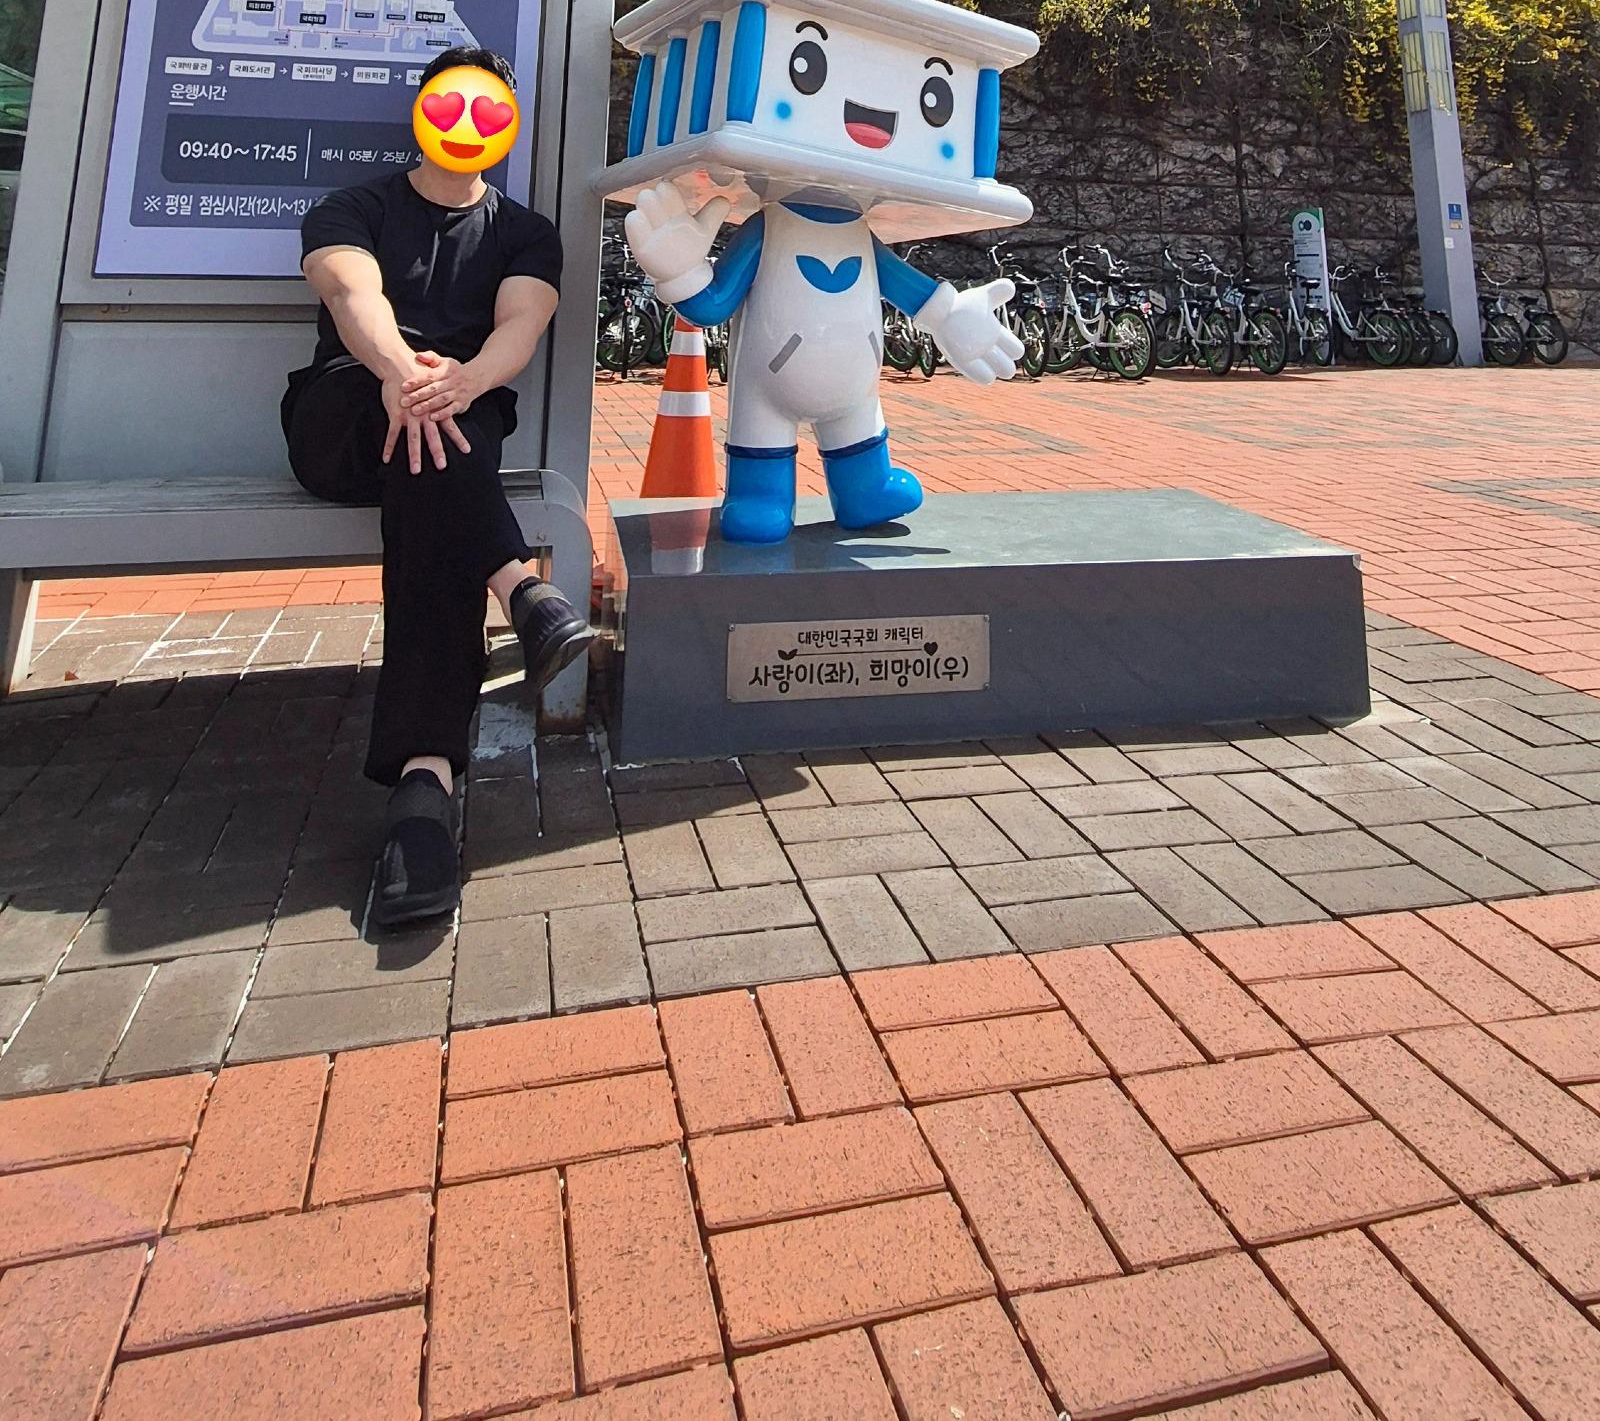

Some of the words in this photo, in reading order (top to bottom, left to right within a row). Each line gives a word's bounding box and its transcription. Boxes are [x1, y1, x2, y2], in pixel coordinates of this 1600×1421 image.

[234, 64, 271, 74] 국회도서관
[296, 65, 333, 75] 국회의사당
[356, 70, 386, 80] 의원회관
[170, 83, 228, 101] 운행시간
[321, 148, 344, 162] 매시
[348, 150, 378, 163] 05분/
[382, 151, 412, 164] 25분/
[165, 194, 193, 216] 평일
[797, 627, 878, 648] 대한민국국회
[884, 626, 924, 645] 캐릭터
[748, 661, 860, 694] 사랑이(좌),
[869, 657, 970, 689] 희망이(우)
